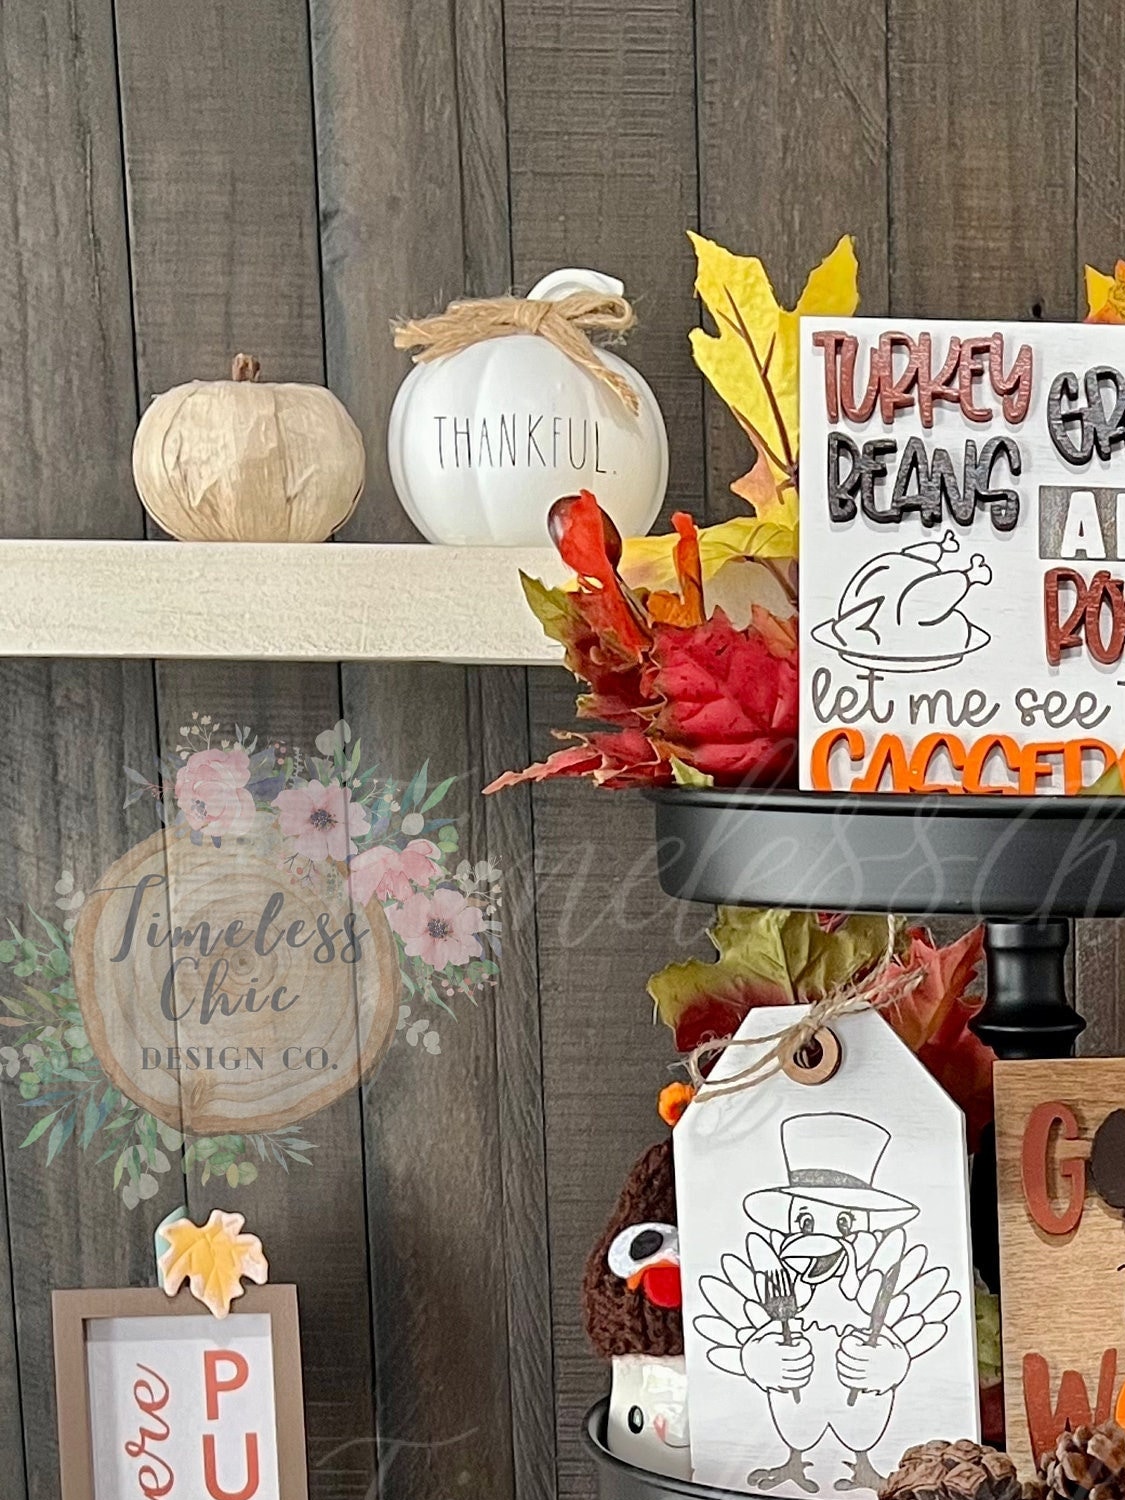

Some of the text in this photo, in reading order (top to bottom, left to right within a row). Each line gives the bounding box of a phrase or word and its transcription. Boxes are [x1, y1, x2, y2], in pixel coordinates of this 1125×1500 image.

[812, 332, 1033, 428] TURKEY
[827, 431, 1021, 532] BEANS
[812, 667, 894, 724] let
[909, 688, 1001, 728] me
[1015, 688, 1112, 729] see
